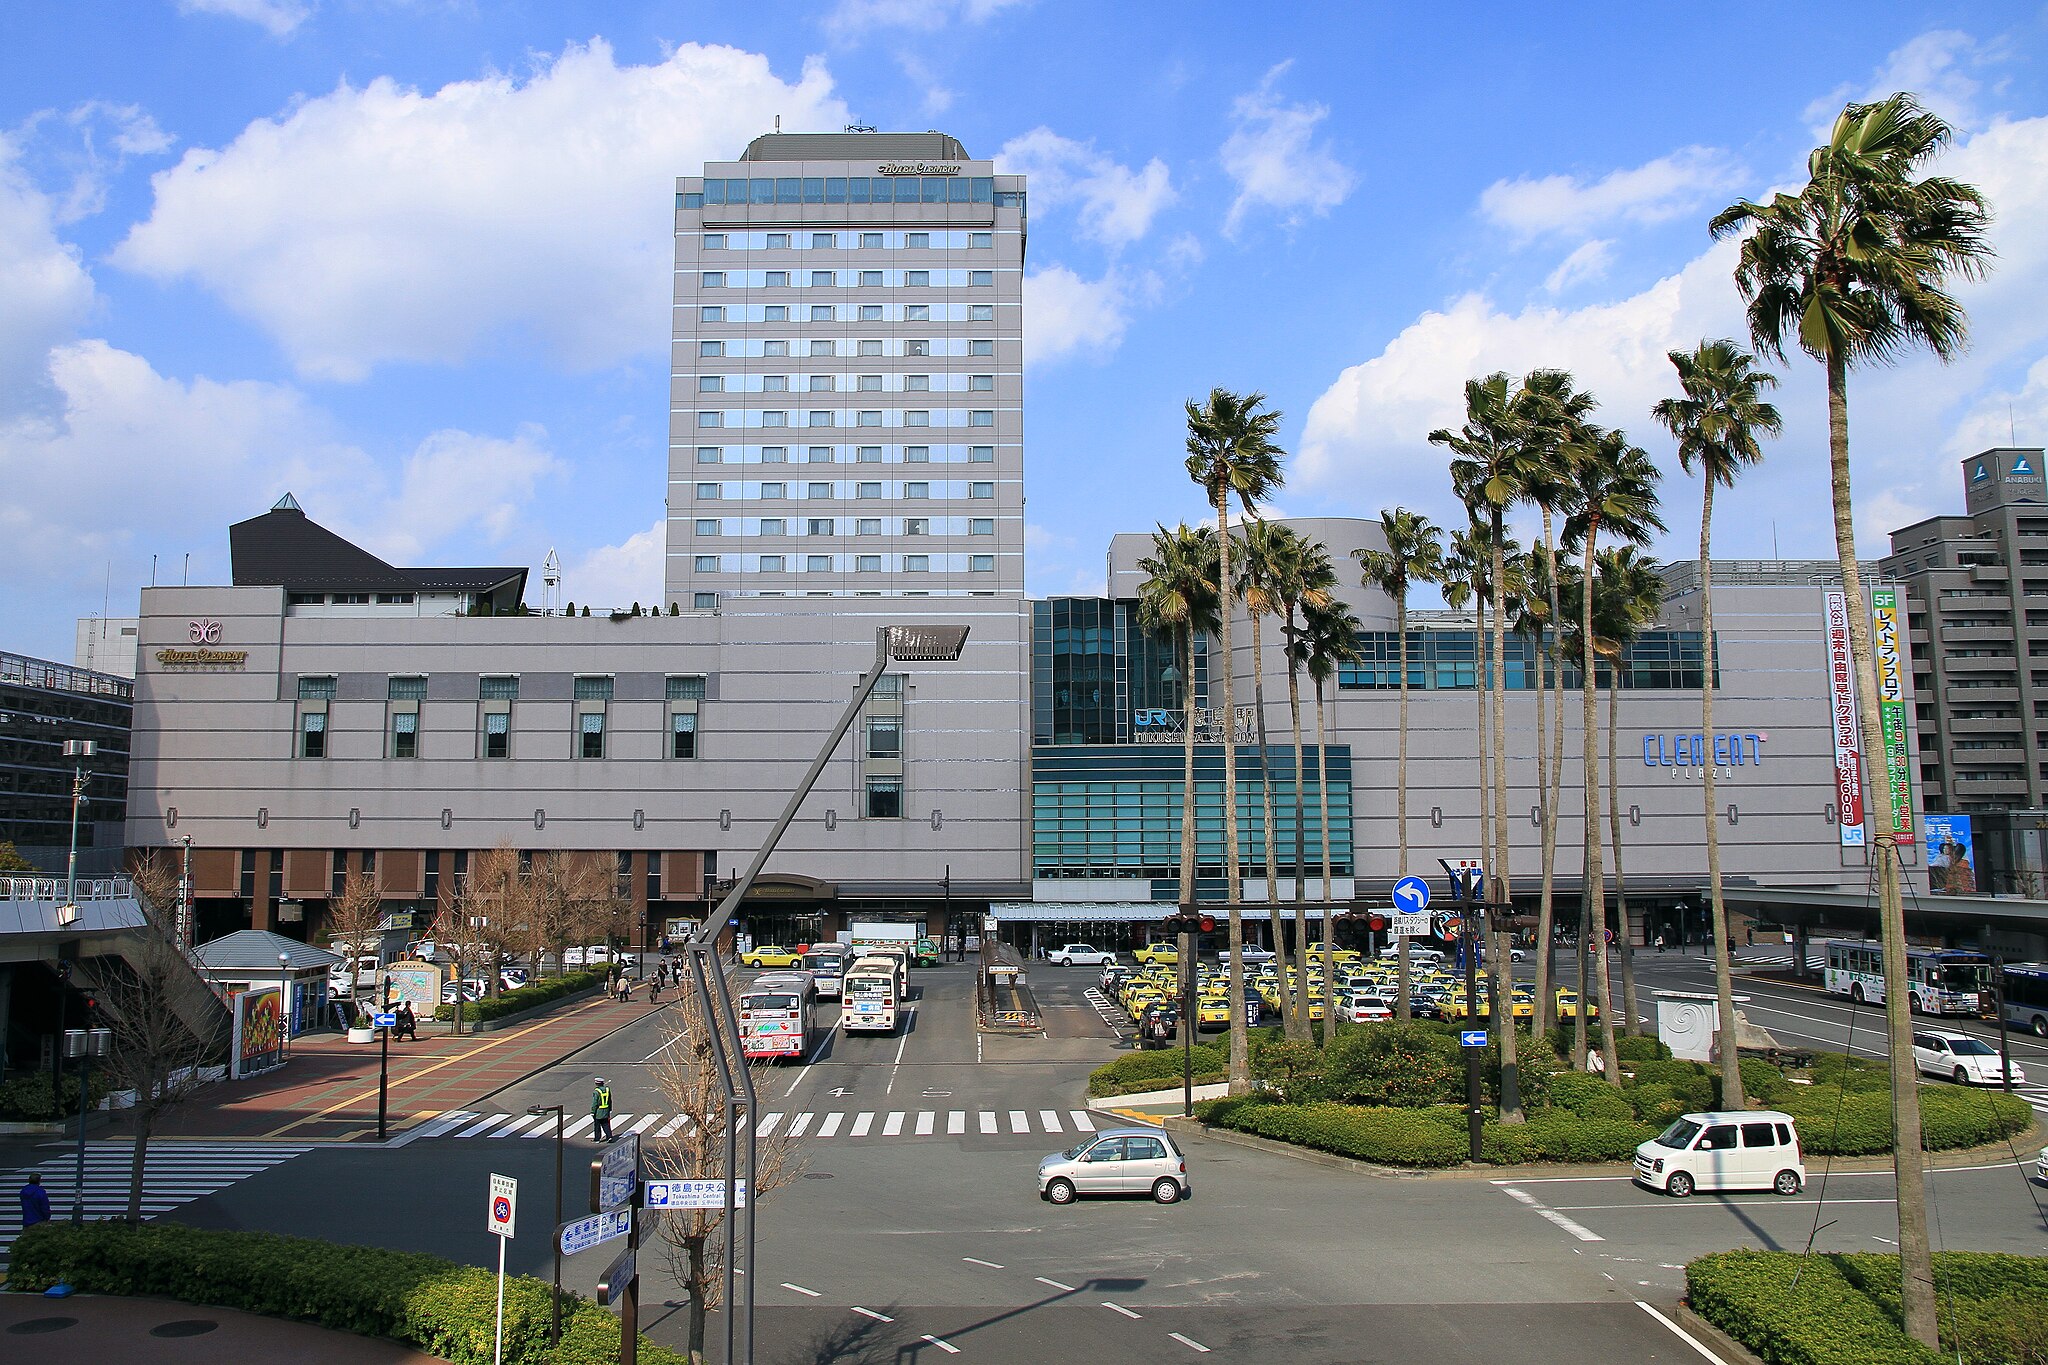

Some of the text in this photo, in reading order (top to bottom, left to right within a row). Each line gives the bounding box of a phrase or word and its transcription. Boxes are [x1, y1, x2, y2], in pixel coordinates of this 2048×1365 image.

[1875, 595, 1893, 606] 5F
[1879, 609, 1898, 701] レストランフロア
[1135, 708, 1167, 726] JR
[1135, 732, 1204, 743] TOKUSHIA
[1672, 768, 1731, 779] PLAZA
[1844, 829, 1862, 840] JR
[671, 1183, 736, 1193] 徳島中央公
